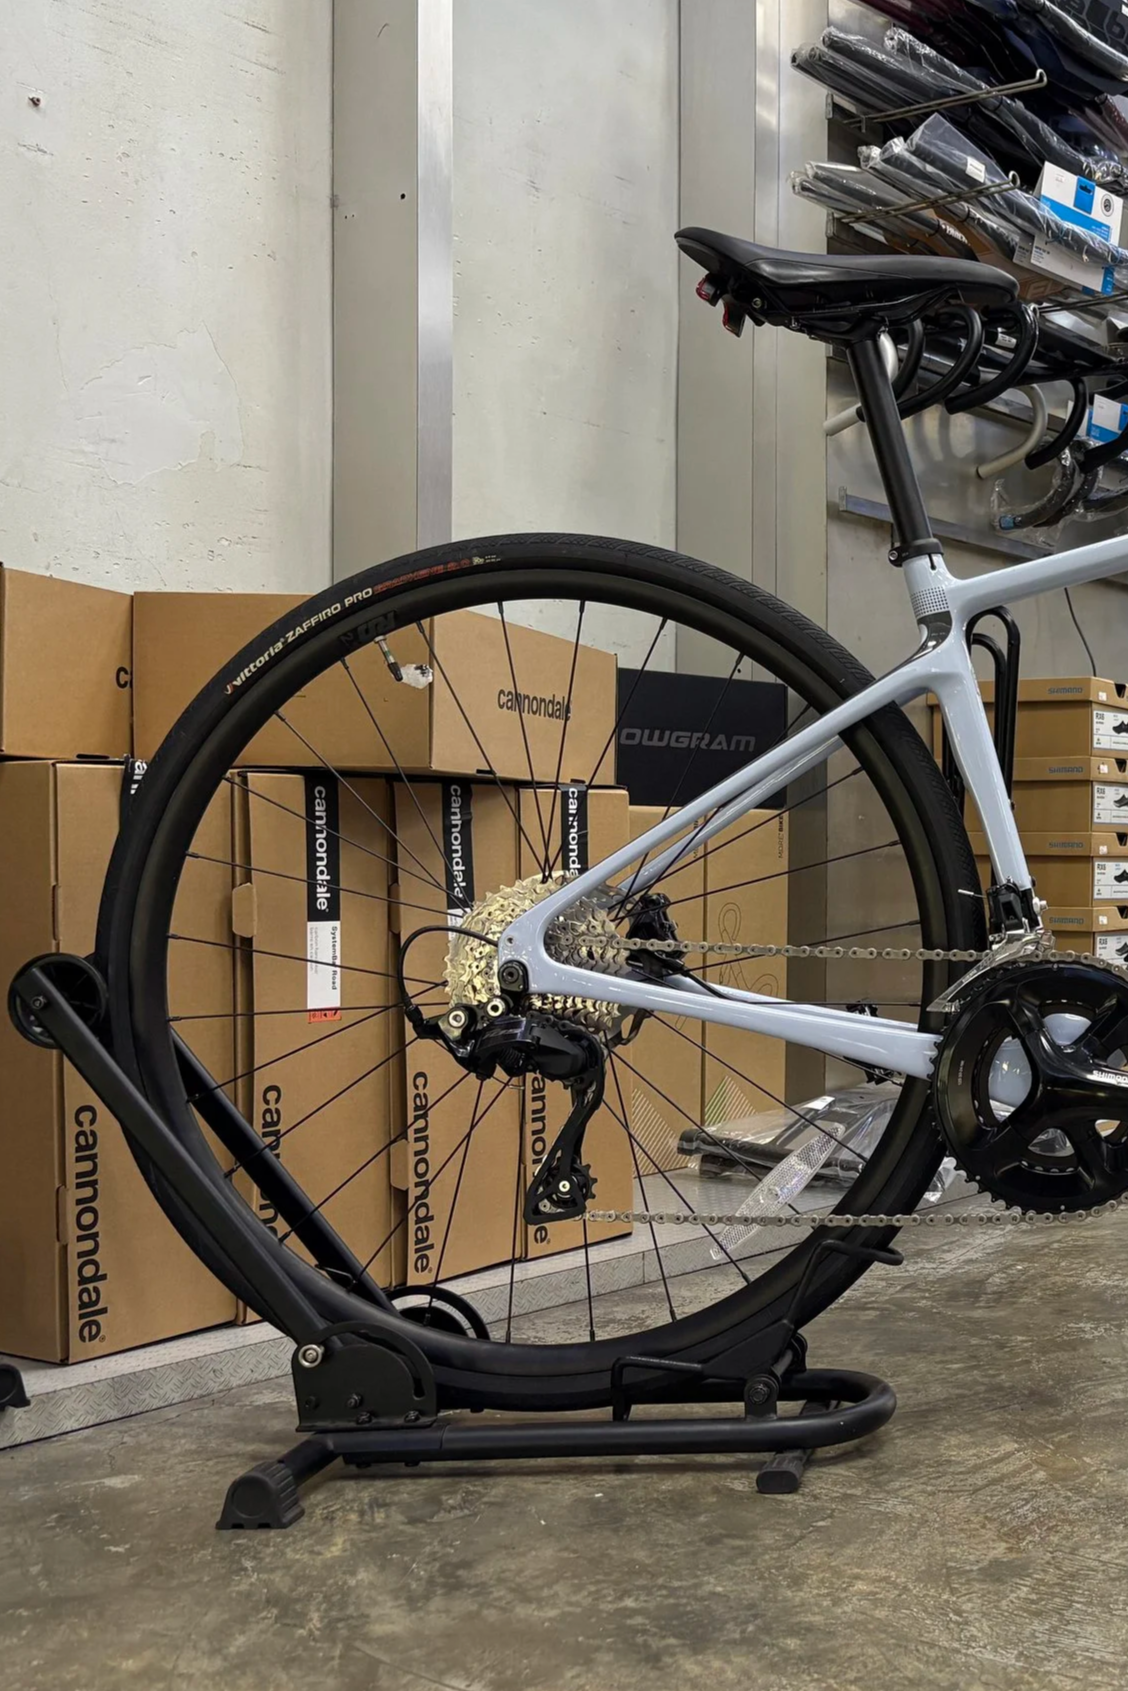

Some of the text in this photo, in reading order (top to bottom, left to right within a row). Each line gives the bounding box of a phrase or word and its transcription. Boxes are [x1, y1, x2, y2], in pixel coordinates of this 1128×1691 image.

[285, 602, 341, 643] ZAFFIRO
[343, 587, 373, 607] PRO
[497, 688, 572, 721] cannondale
[314, 785, 331, 912] cannondale
[450, 784, 466, 898] cannondale
[568, 787, 582, 878] cannonda
[74, 1104, 108, 1344] cannondale
[412, 1070, 435, 1274] cannondale
